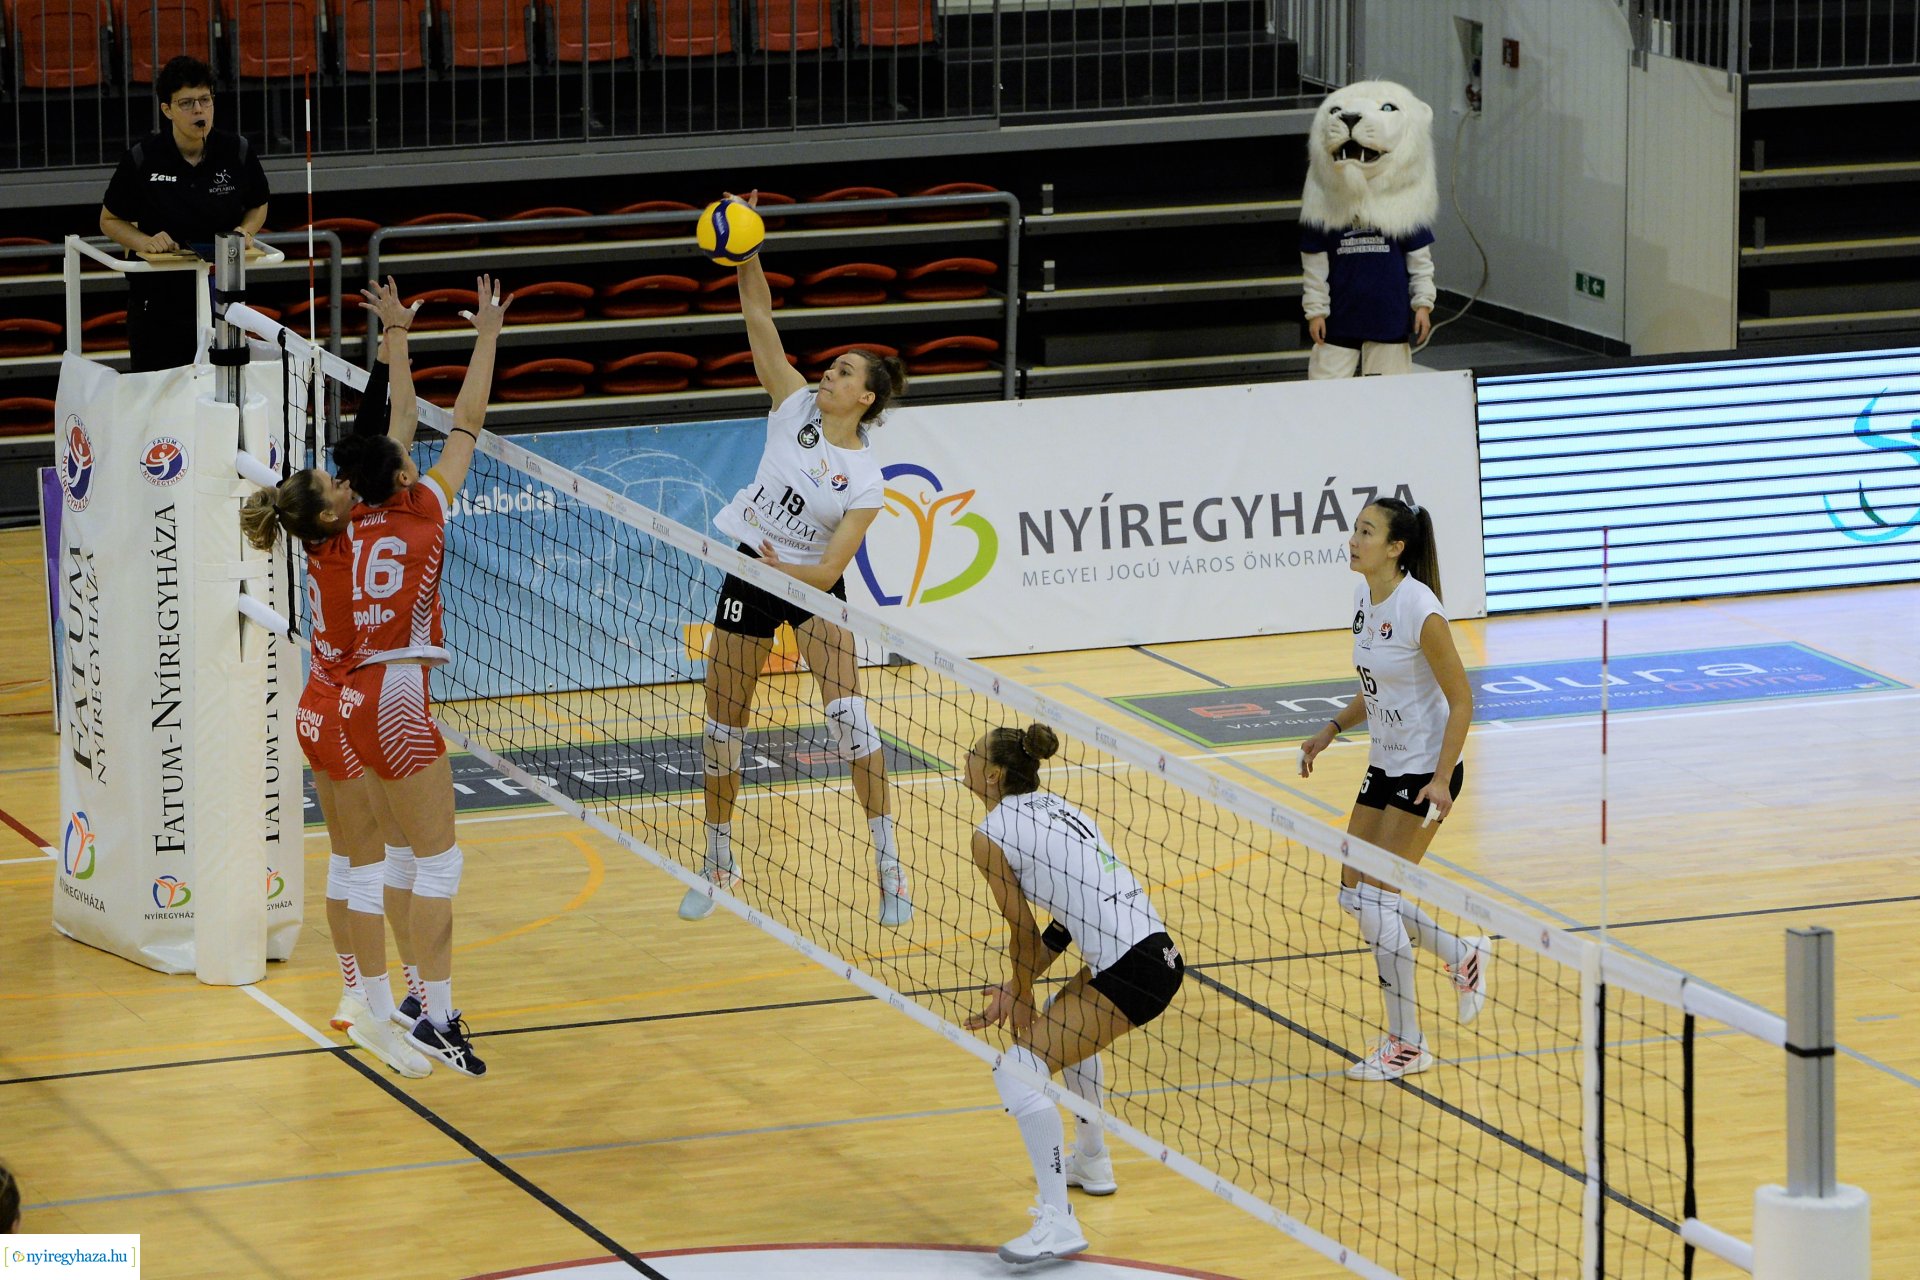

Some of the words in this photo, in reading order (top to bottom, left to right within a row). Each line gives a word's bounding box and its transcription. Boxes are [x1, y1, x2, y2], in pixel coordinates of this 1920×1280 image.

[150, 173, 177, 182] Zeus
[152, 438, 177, 446] FATUM
[753, 484, 817, 541] FATUM
[780, 485, 805, 516] 19
[1019, 476, 1416, 556] NYÍREGYHÁZA
[352, 536, 407, 599] 16
[1022, 567, 1097, 587] MEGYEI
[1107, 557, 1160, 581] JOGÚ
[1169, 551, 1235, 576] VÁROS
[1244, 543, 1349, 569] ÖNKORMÁ
[723, 597, 743, 623] 19
[69, 544, 93, 779] FATUM
[84, 552, 107, 786] NYÍREGYHÁZA
[152, 501, 186, 855] FATUM-NYÍREGYHÁZA
[1356, 665, 1378, 695] 15
[300, 721, 320, 742] 00
[1049, 808, 1096, 840] 11
[59, 877, 106, 913] NYÍREGYHÁZA
[267, 900, 293, 911] GYHÁZA
[144, 911, 195, 920] NYÍREGYHÁZ
[1050, 1145, 1062, 1174] MIKASA
